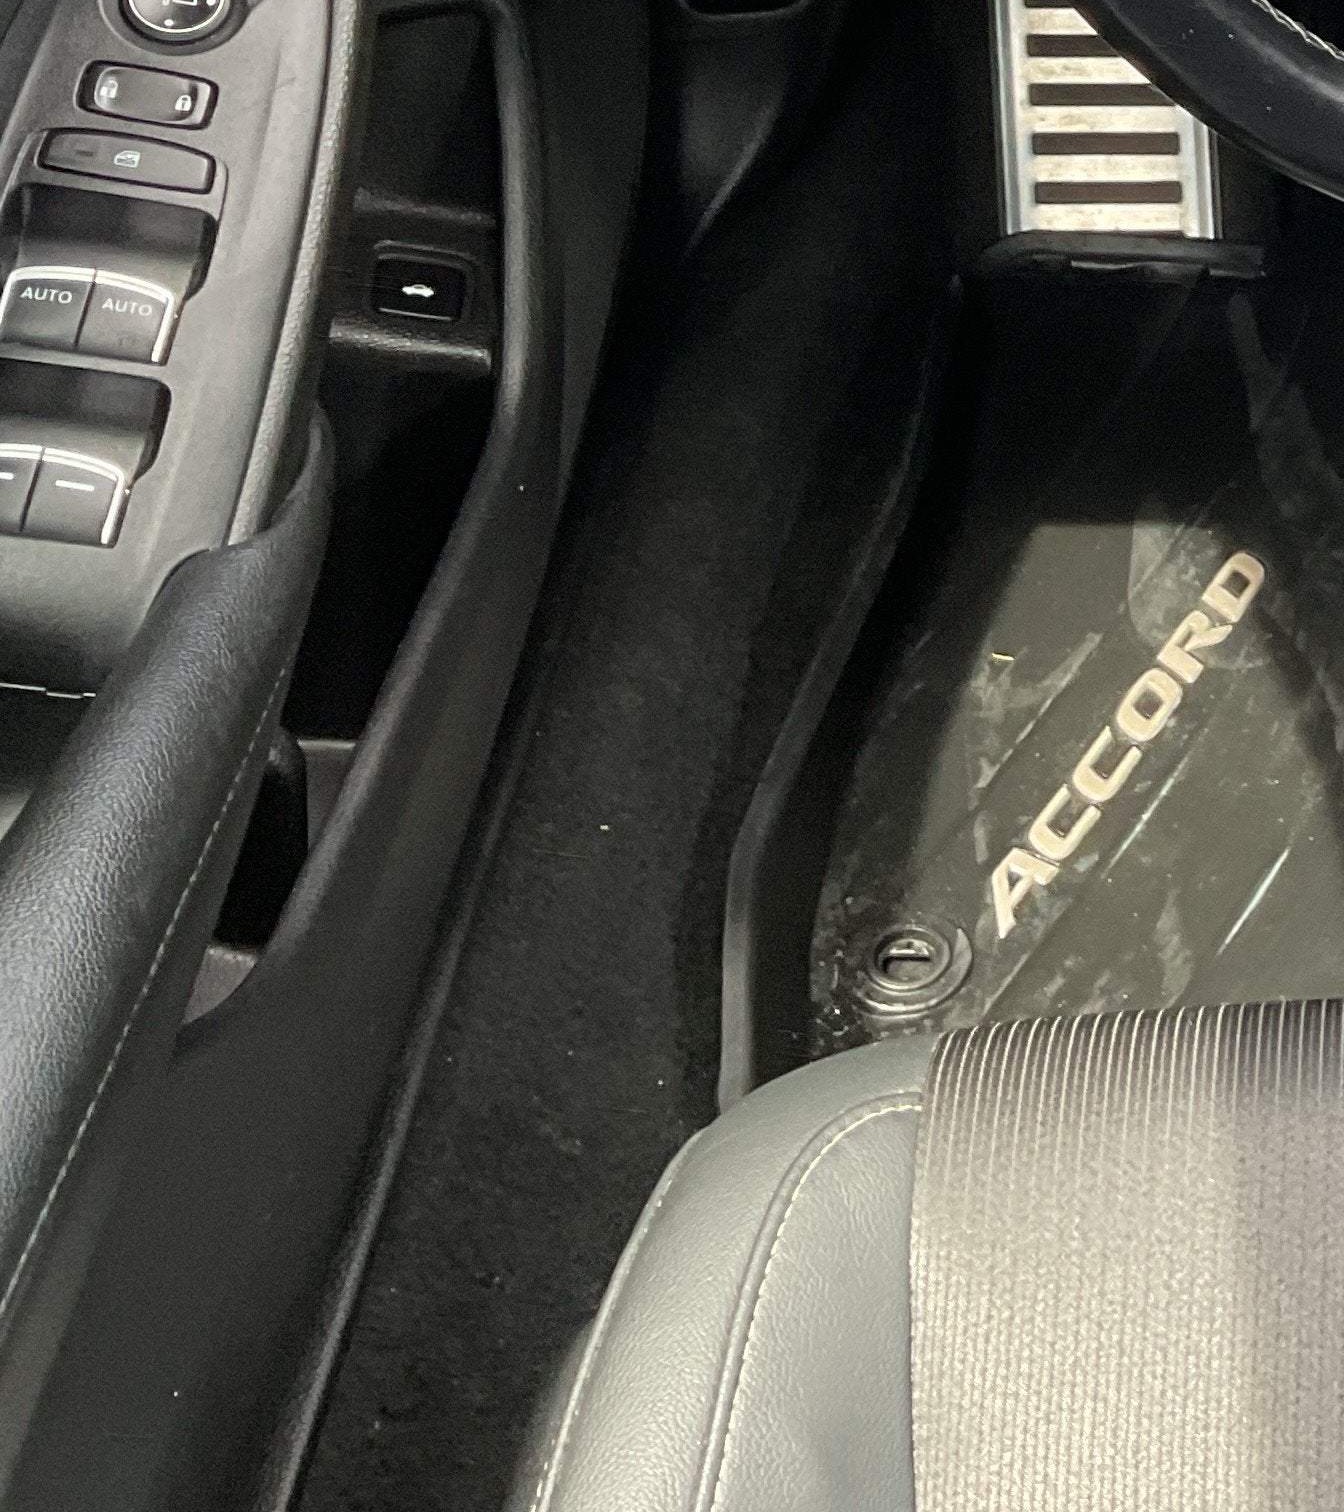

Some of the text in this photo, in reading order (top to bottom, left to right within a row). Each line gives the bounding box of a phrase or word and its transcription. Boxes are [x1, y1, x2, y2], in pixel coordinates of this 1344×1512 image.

[20, 285, 74, 305] AUTO
[101, 297, 154, 317] AUTO
[989, 548, 1266, 940] ACCORD
